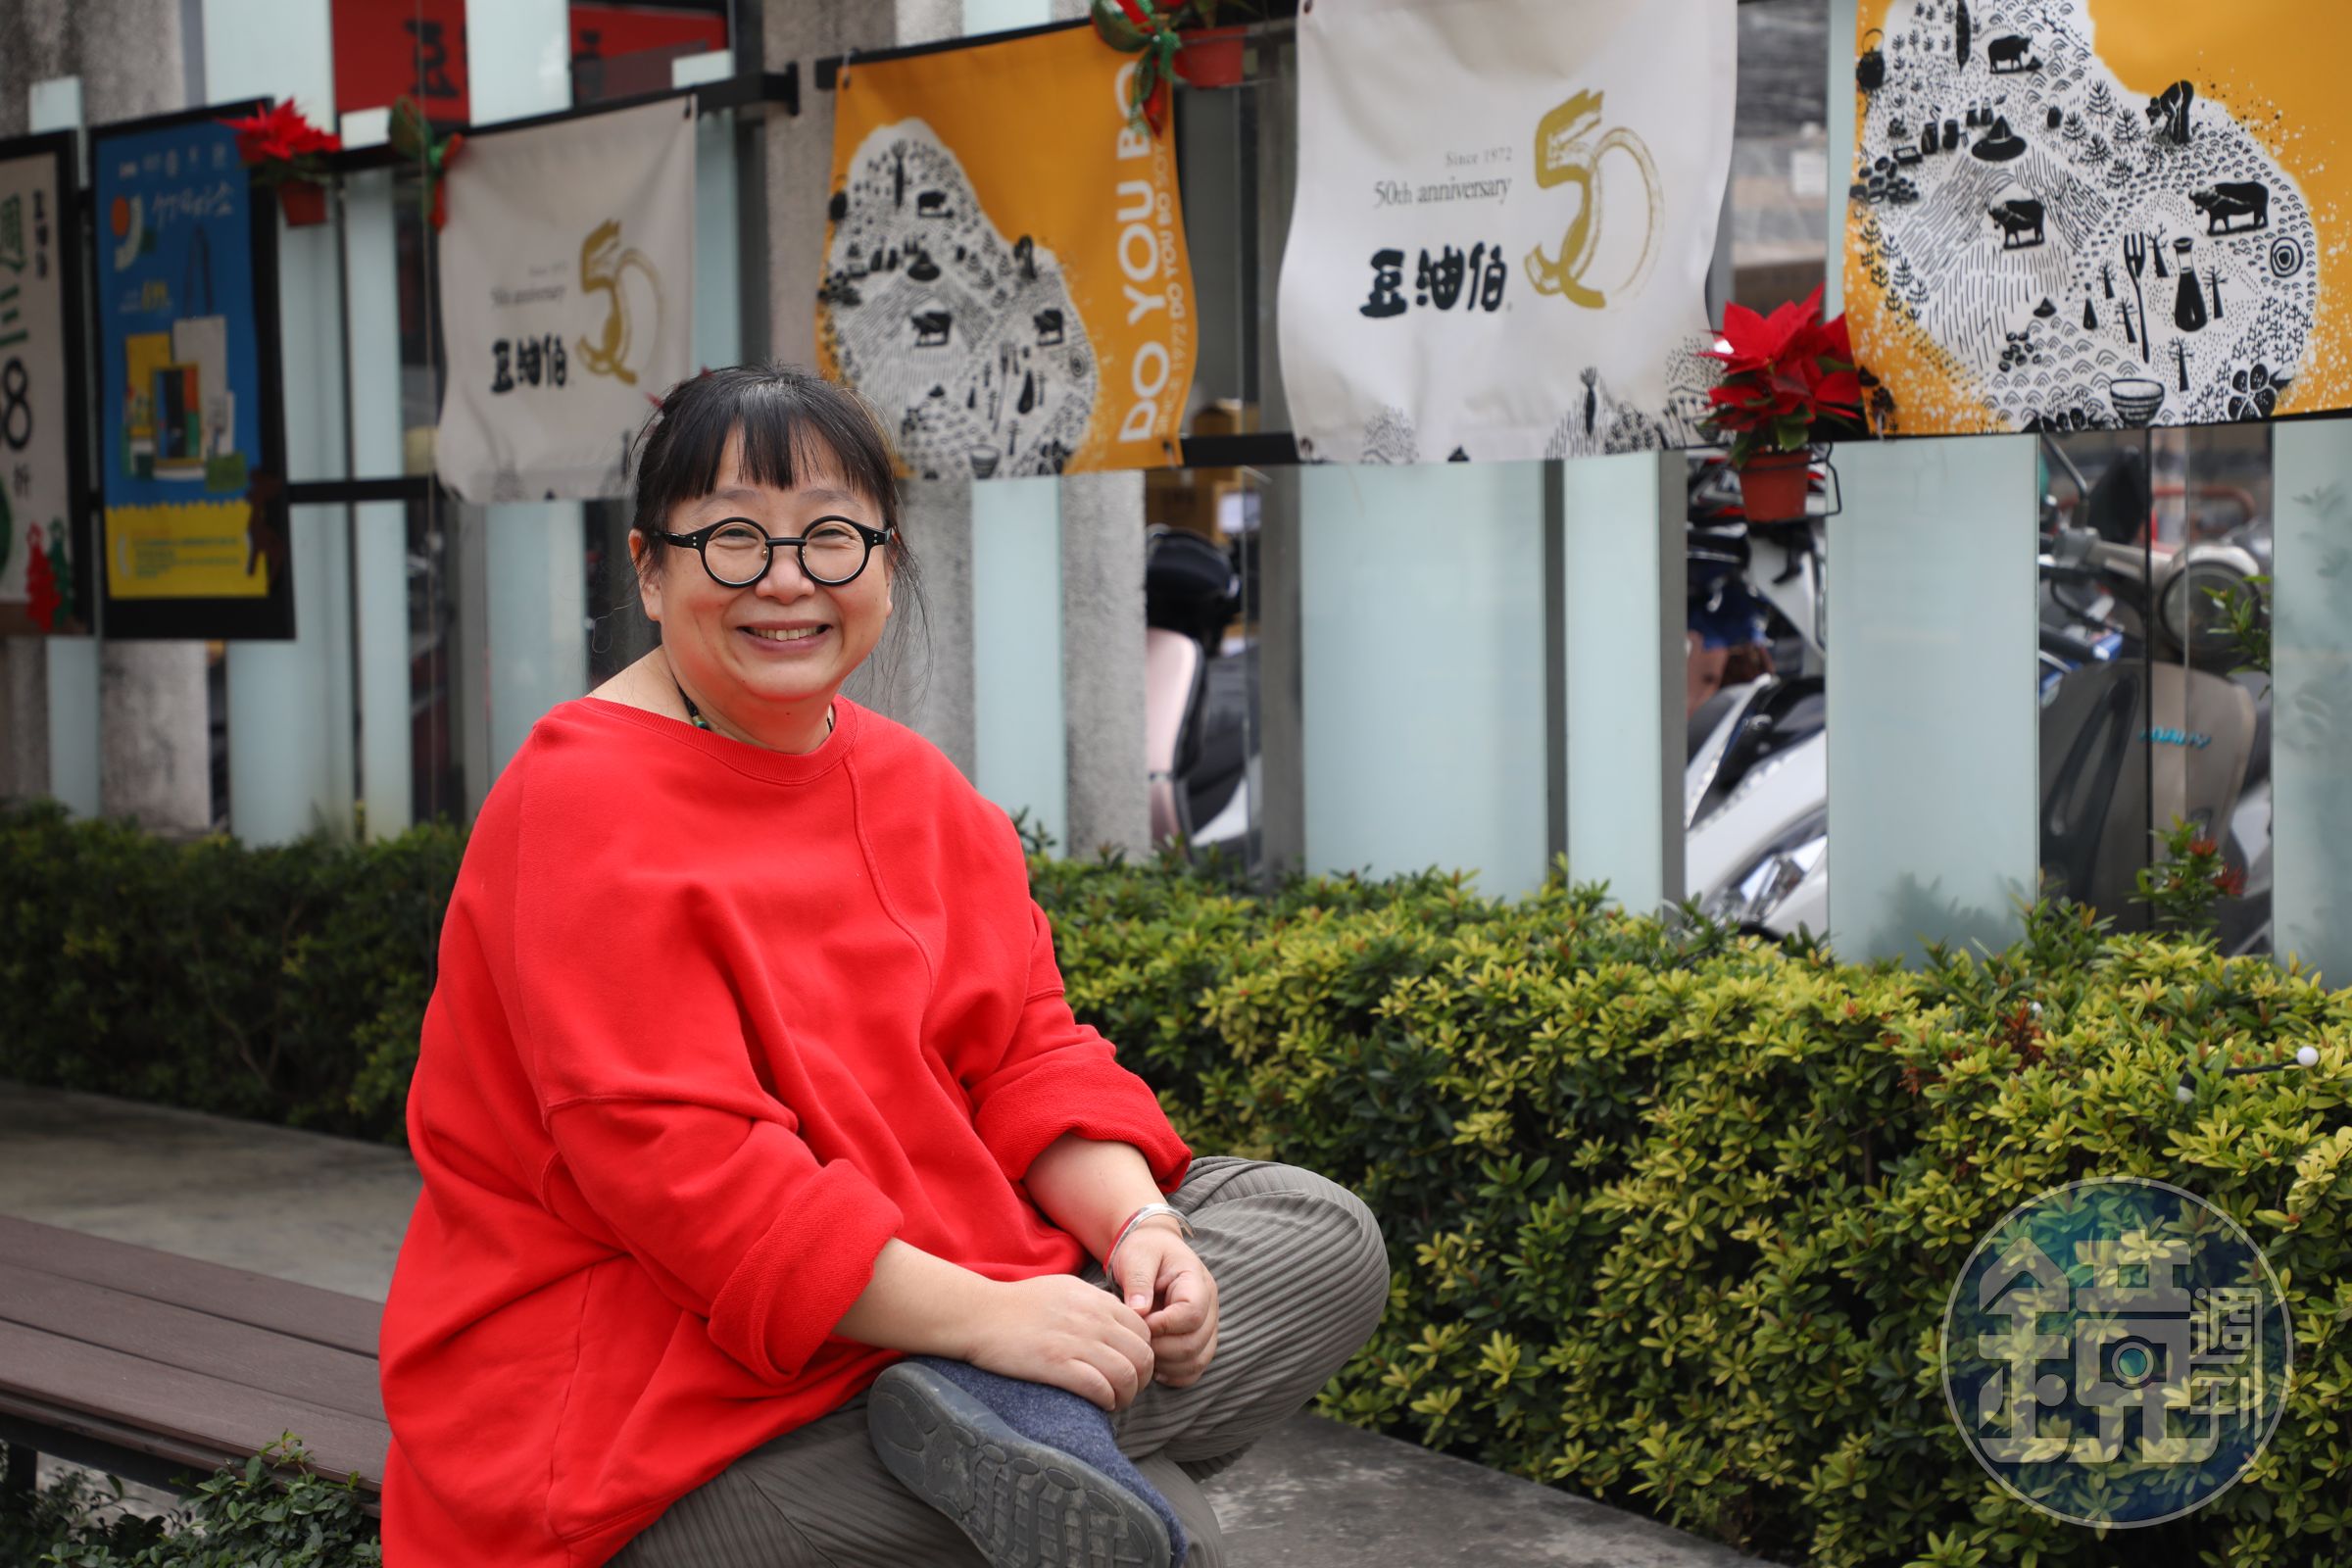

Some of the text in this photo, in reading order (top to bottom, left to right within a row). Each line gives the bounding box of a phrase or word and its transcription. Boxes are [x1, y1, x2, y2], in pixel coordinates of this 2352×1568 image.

[1445, 147, 1512, 168] Since 1972
[1156, 191, 1173, 226] BO
[1374, 175, 1512, 209] 50th anniversary
[1525, 88, 1665, 310] 50
[1116, 179, 1166, 325] YOU
[1159, 229, 1180, 279] YOU
[1166, 282, 1186, 319] DO
[1359, 241, 1508, 319] 豆油伯
[1118, 340, 1170, 442] DO
